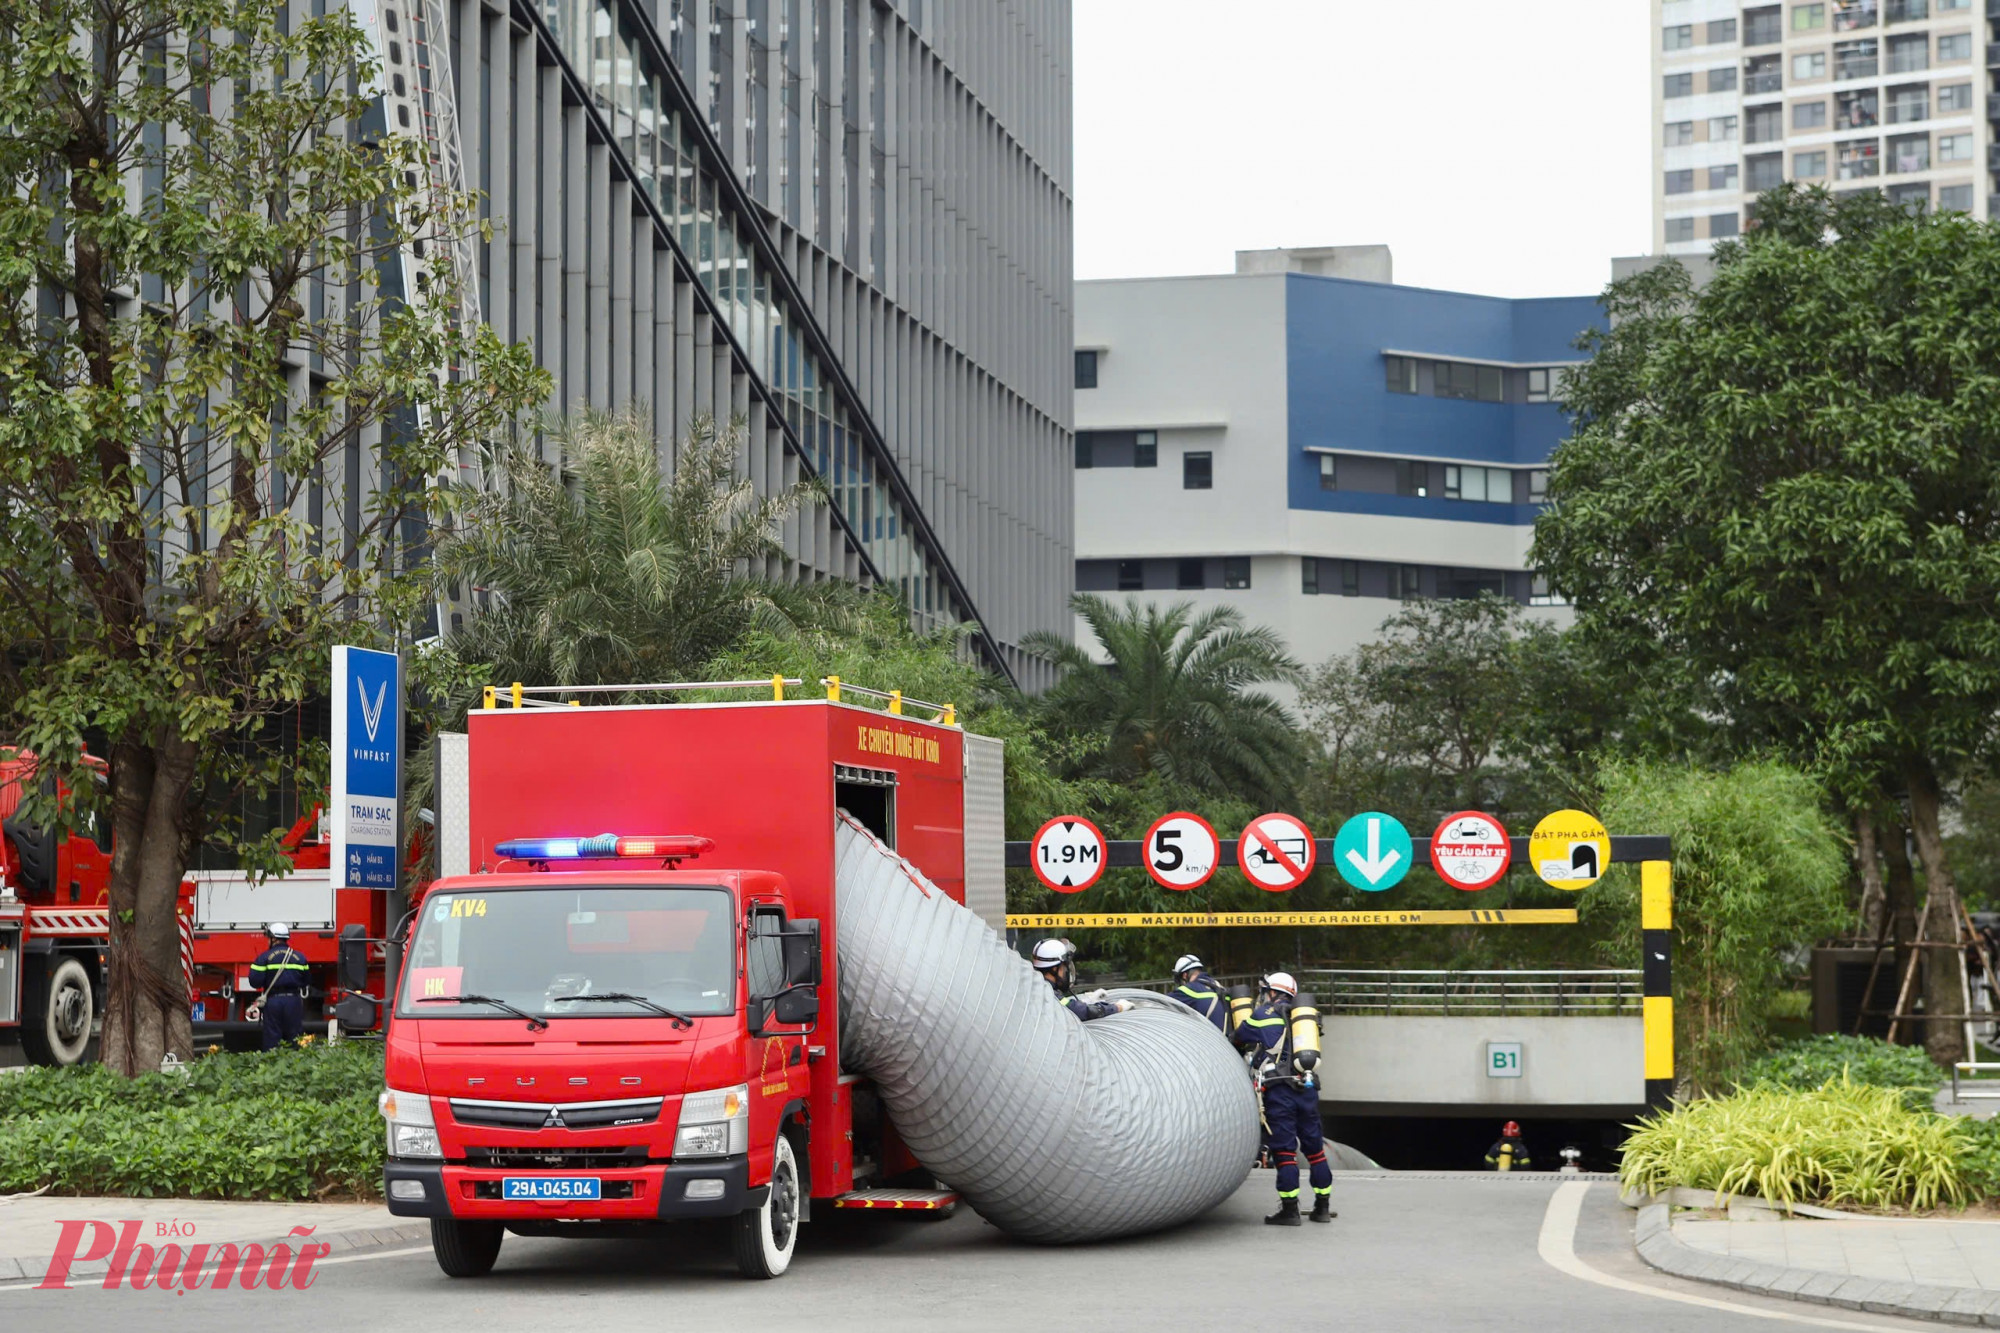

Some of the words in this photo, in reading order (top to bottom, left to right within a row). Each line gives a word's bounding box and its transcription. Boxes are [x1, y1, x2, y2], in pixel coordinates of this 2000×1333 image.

[857, 725, 867, 751] XE
[353, 748, 390, 763] VINFAST
[351, 805, 374, 822] TRẠM
[375, 807, 391, 824] SẠC
[351, 826, 373, 836] CHARGING
[374, 827, 391, 837] STATION
[1557, 830, 1579, 839] PHA
[1040, 844, 1098, 864] 1.9M
[1153, 829, 1184, 872] 5
[1434, 845, 1454, 856] YÊU
[1494, 848, 1507, 857] XE
[450, 899, 487, 918] KV4
[1091, 916, 1128, 926] 1.9M
[1141, 916, 1218, 925] MAXIMUM
[1225, 915, 1283, 925] HEIGHT
[424, 978, 446, 996] HK
[1493, 1051, 1516, 1069] B1
[467, 1077, 642, 1086] FUSO
[511, 1181, 592, 1196] 29A-045.04
